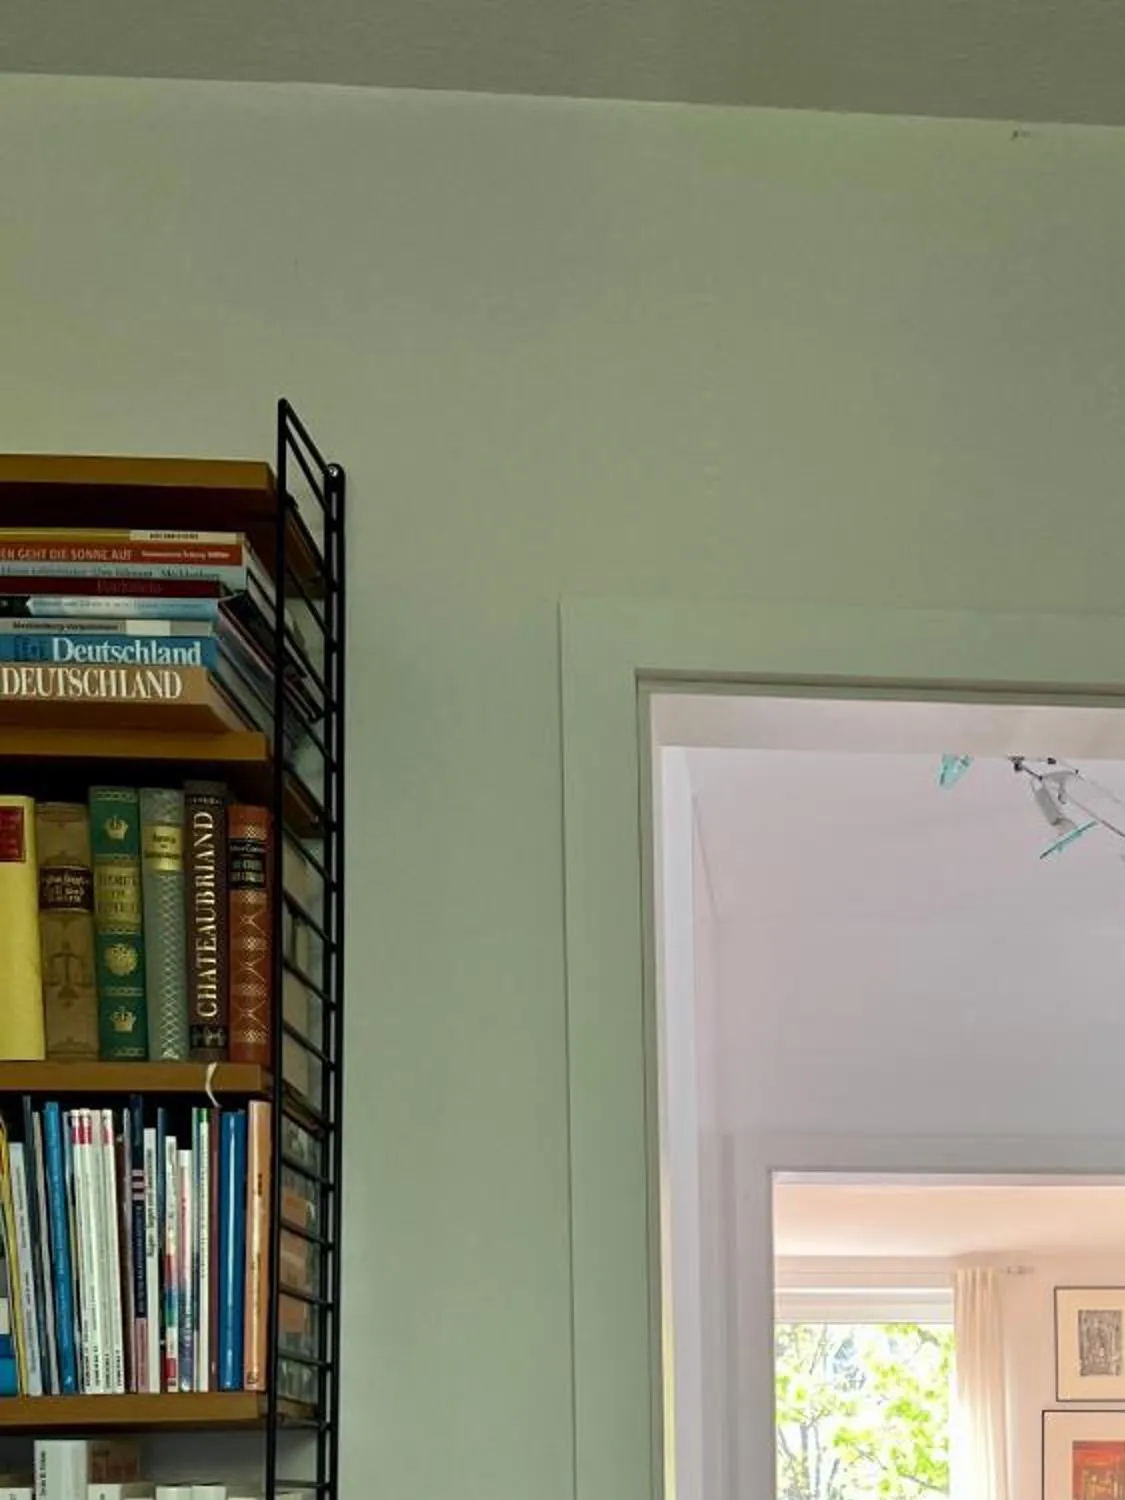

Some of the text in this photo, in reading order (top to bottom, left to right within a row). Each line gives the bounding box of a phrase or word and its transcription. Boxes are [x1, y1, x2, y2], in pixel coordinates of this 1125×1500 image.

[52, 637, 202, 665] Deutschland
[1, 667, 184, 699] DEUTSCHLAND
[193, 811, 219, 1018] CHATEAUBRIAND
